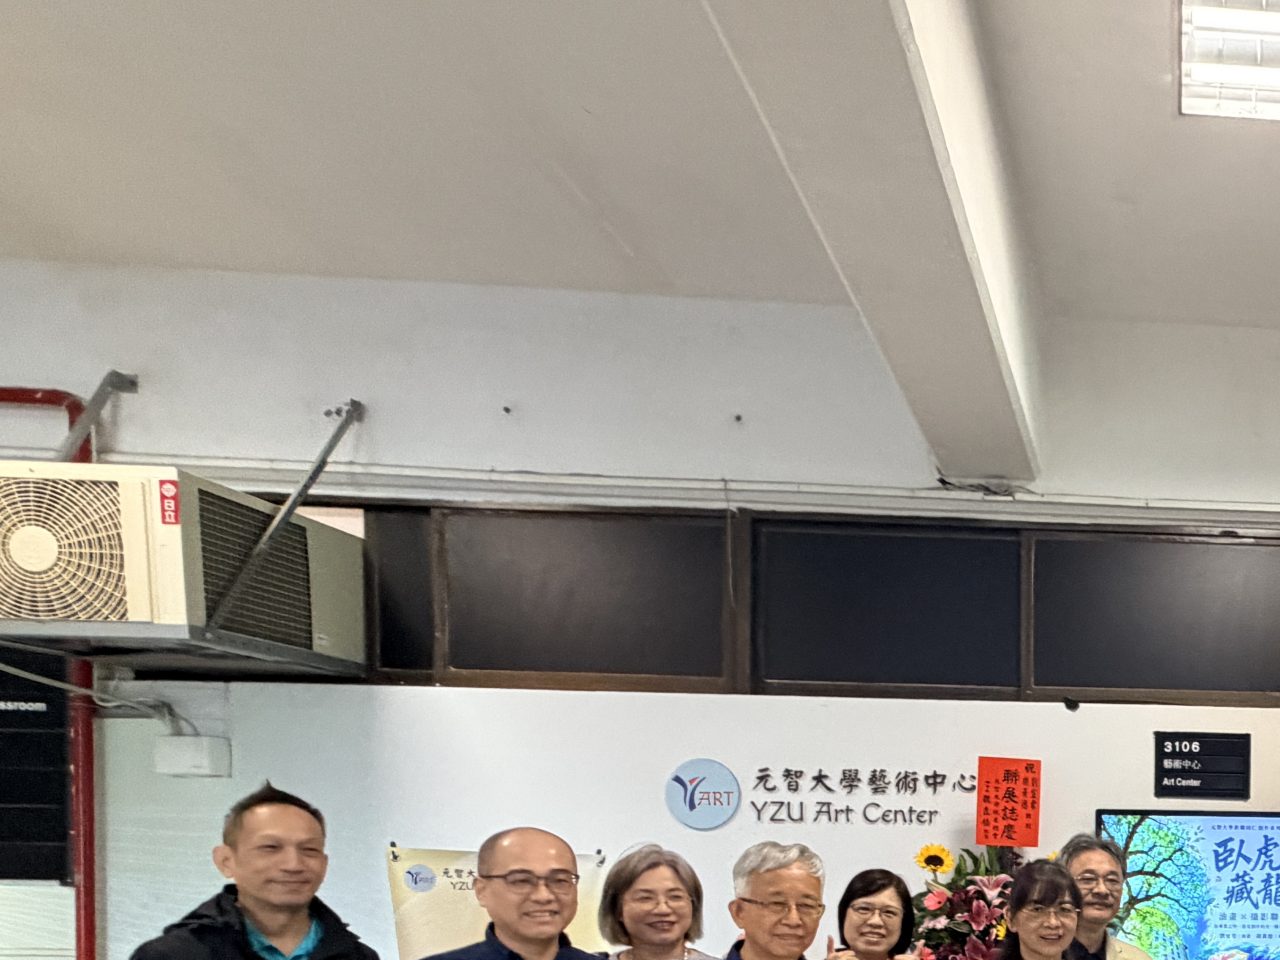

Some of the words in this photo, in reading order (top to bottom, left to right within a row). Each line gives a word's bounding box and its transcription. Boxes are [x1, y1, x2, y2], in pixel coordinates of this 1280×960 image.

[163, 499, 176, 523] 日立
[1163, 741, 1201, 753] 3106
[751, 767, 978, 795] 元智大學藝術中心
[1162, 777, 1175, 786] Art
[1175, 777, 1202, 787] Center
[750, 801, 805, 823] YZU
[812, 801, 855, 824] Art
[862, 802, 940, 825] Center
[1001, 768, 1019, 841] 聯展誌慶
